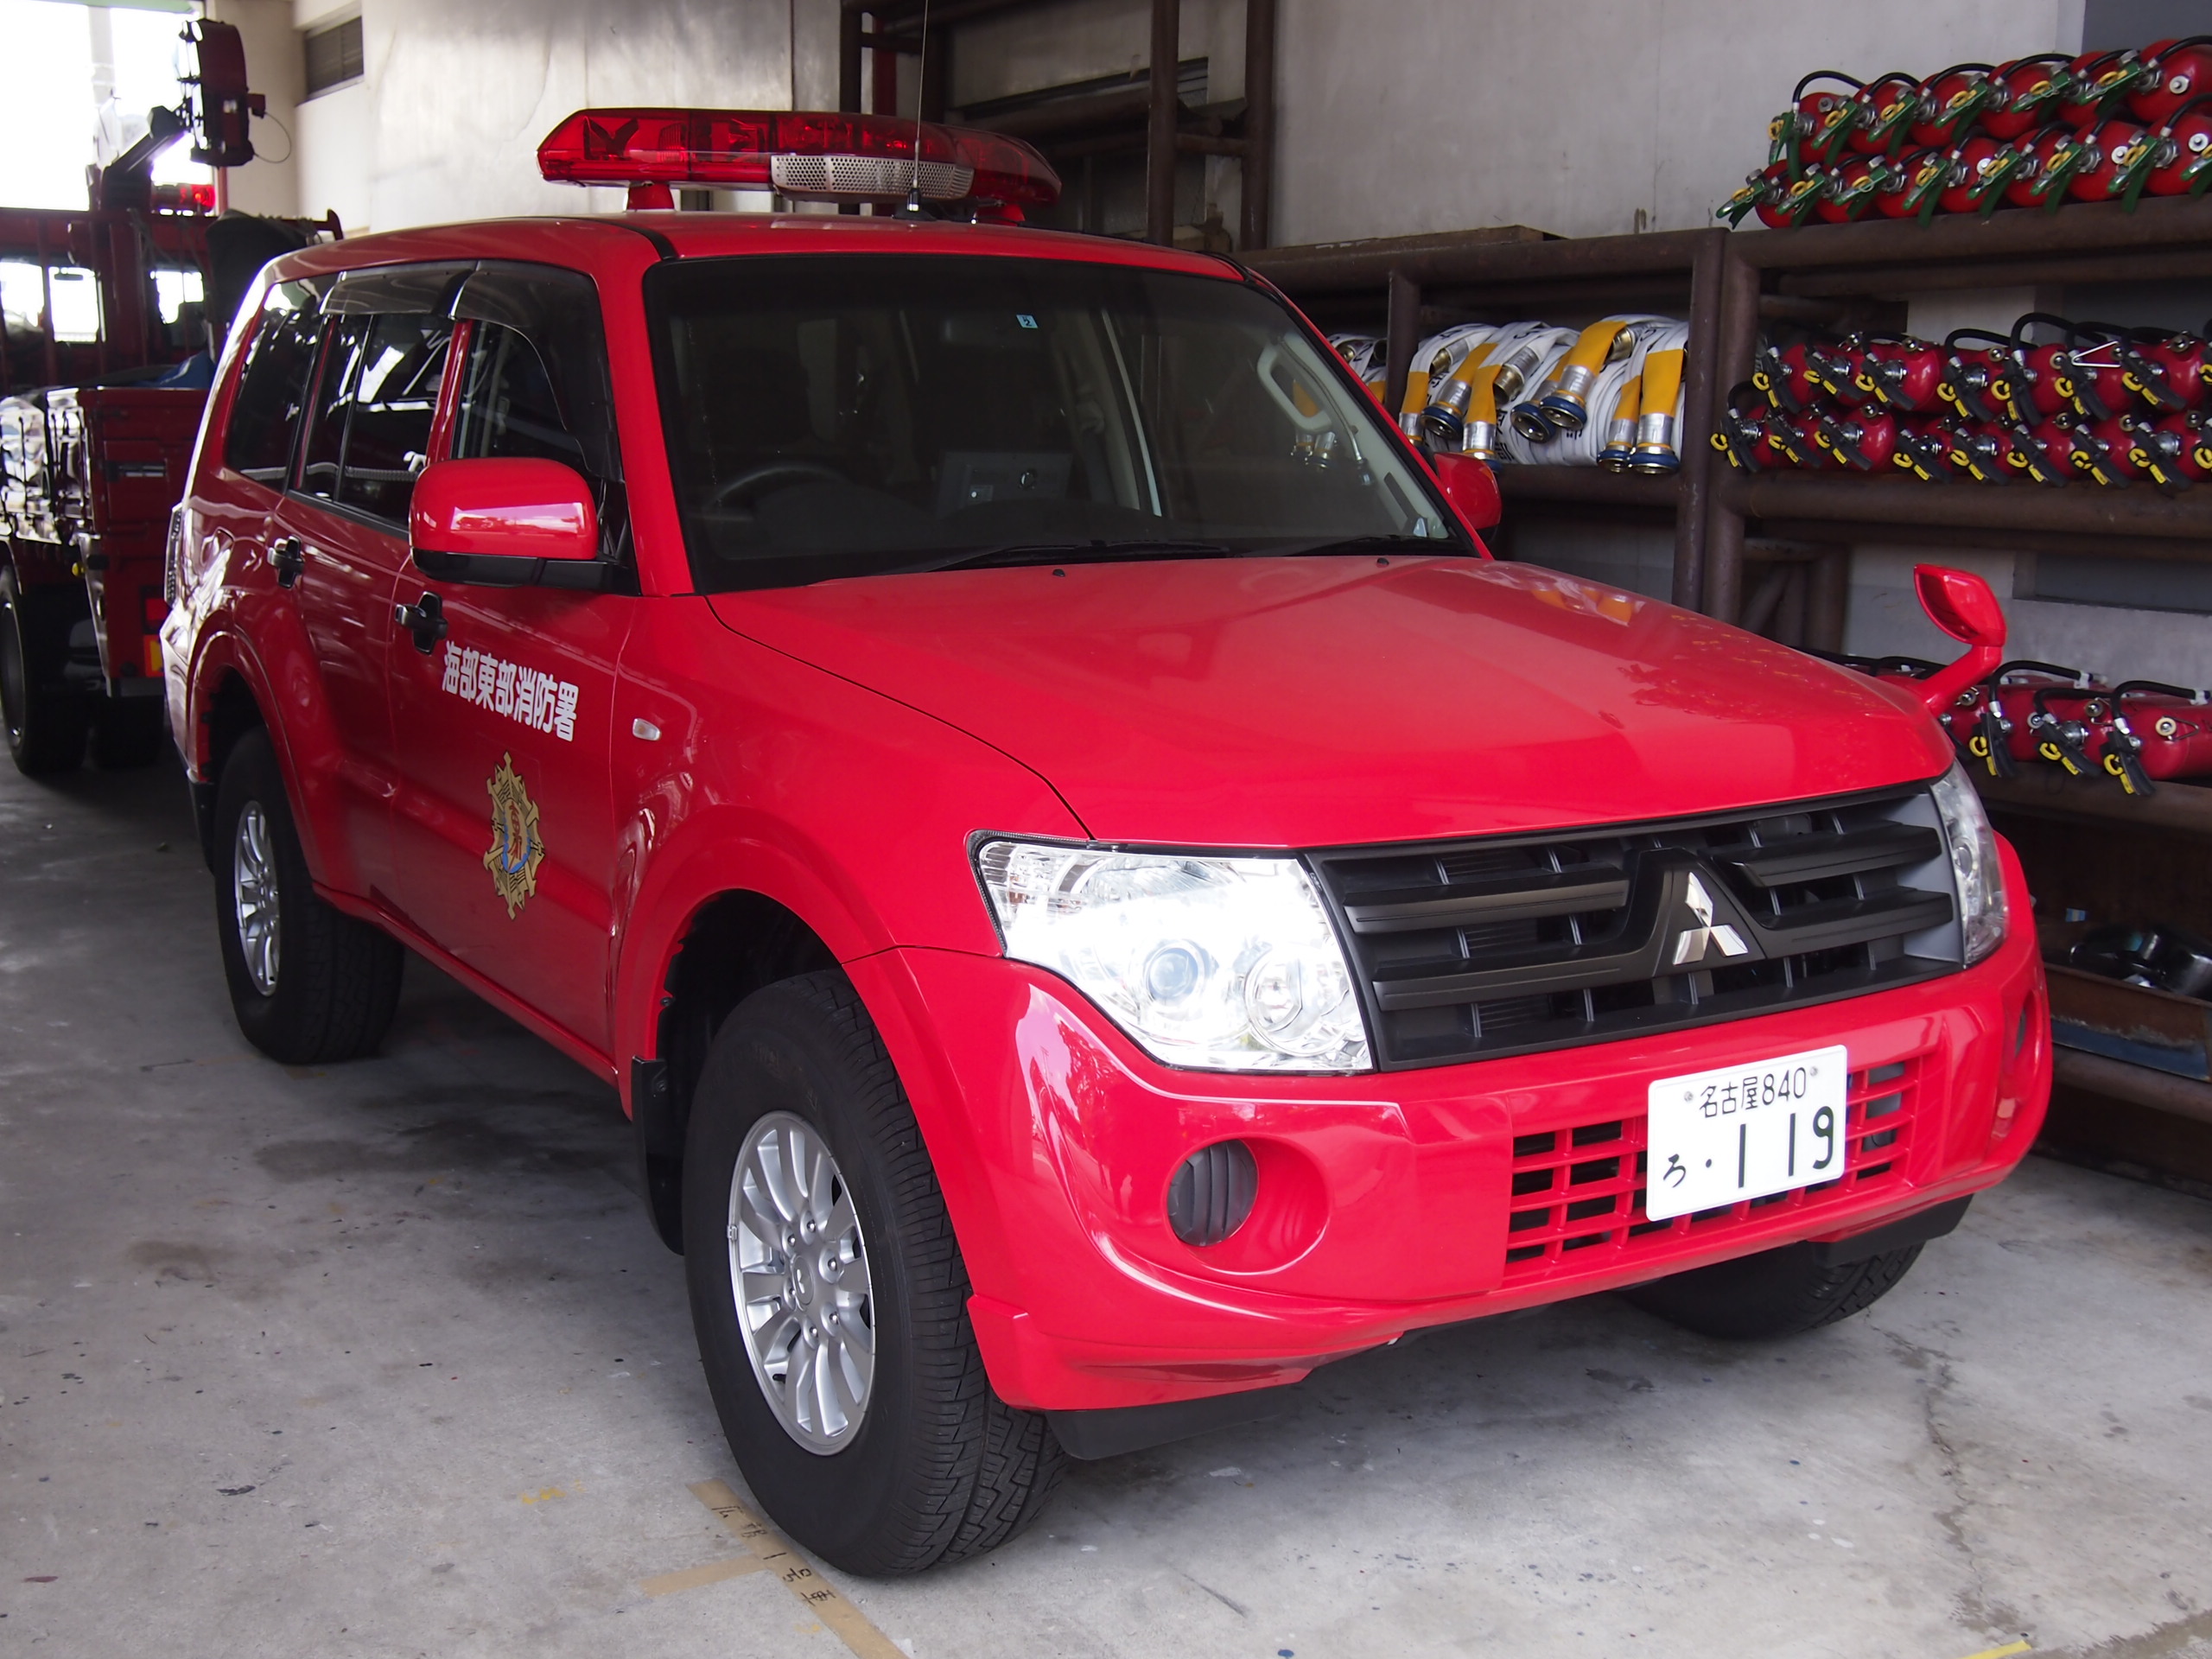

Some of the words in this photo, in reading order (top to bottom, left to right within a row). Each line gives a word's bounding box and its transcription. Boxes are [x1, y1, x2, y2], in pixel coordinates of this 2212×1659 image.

[442, 640, 580, 742] 海部東部消防署
